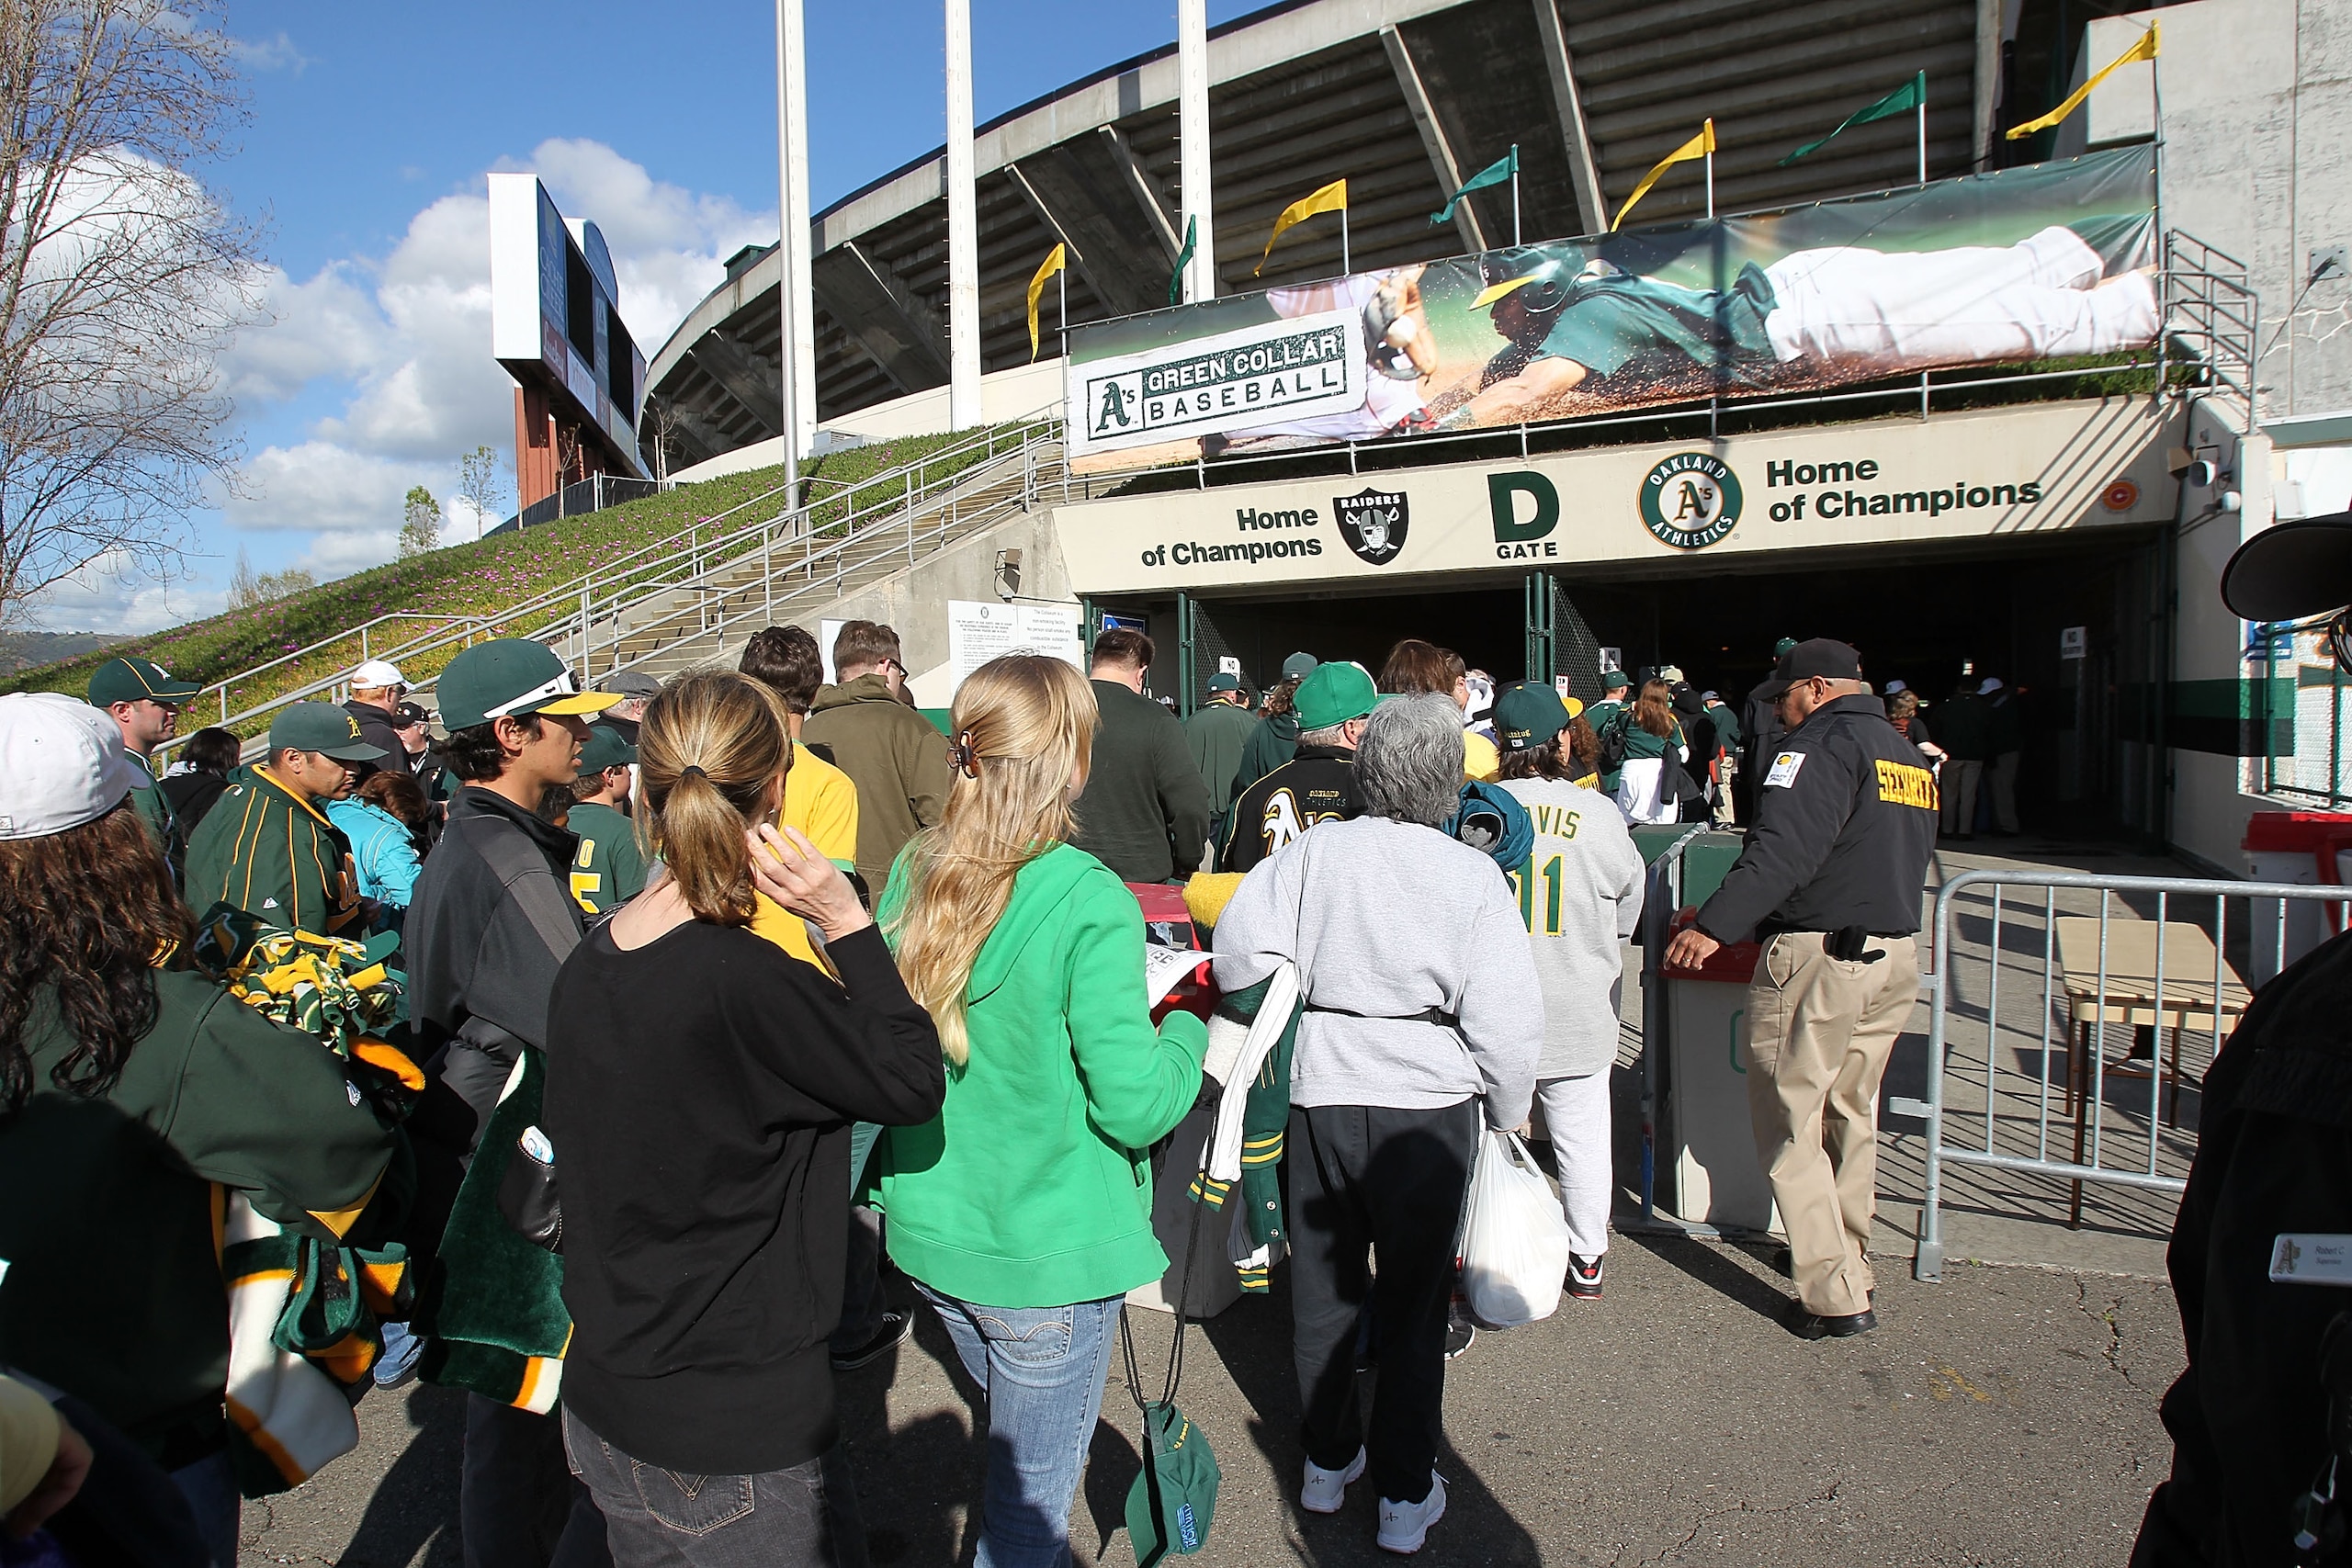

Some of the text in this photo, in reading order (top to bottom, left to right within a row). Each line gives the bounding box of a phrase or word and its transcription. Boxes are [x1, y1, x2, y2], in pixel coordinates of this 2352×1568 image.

[1148, 334, 1339, 392] GREEN COLLAR
[1094, 381, 1136, 434] A's
[1149, 367, 1339, 421] BASEBALL
[1649, 456, 1727, 486] OAKLAND
[1767, 458, 1880, 488] Home
[1340, 494, 1401, 510] RAIDERS
[1487, 470, 1561, 544] D
[1769, 481, 2041, 523] of Champions
[1237, 508, 1319, 532] Home
[1651, 515, 1734, 547] ATHLETICS
[1141, 538, 1323, 567] of Champions
[1497, 541, 1559, 559] GATE
[1227, 660, 1236, 670] NO
